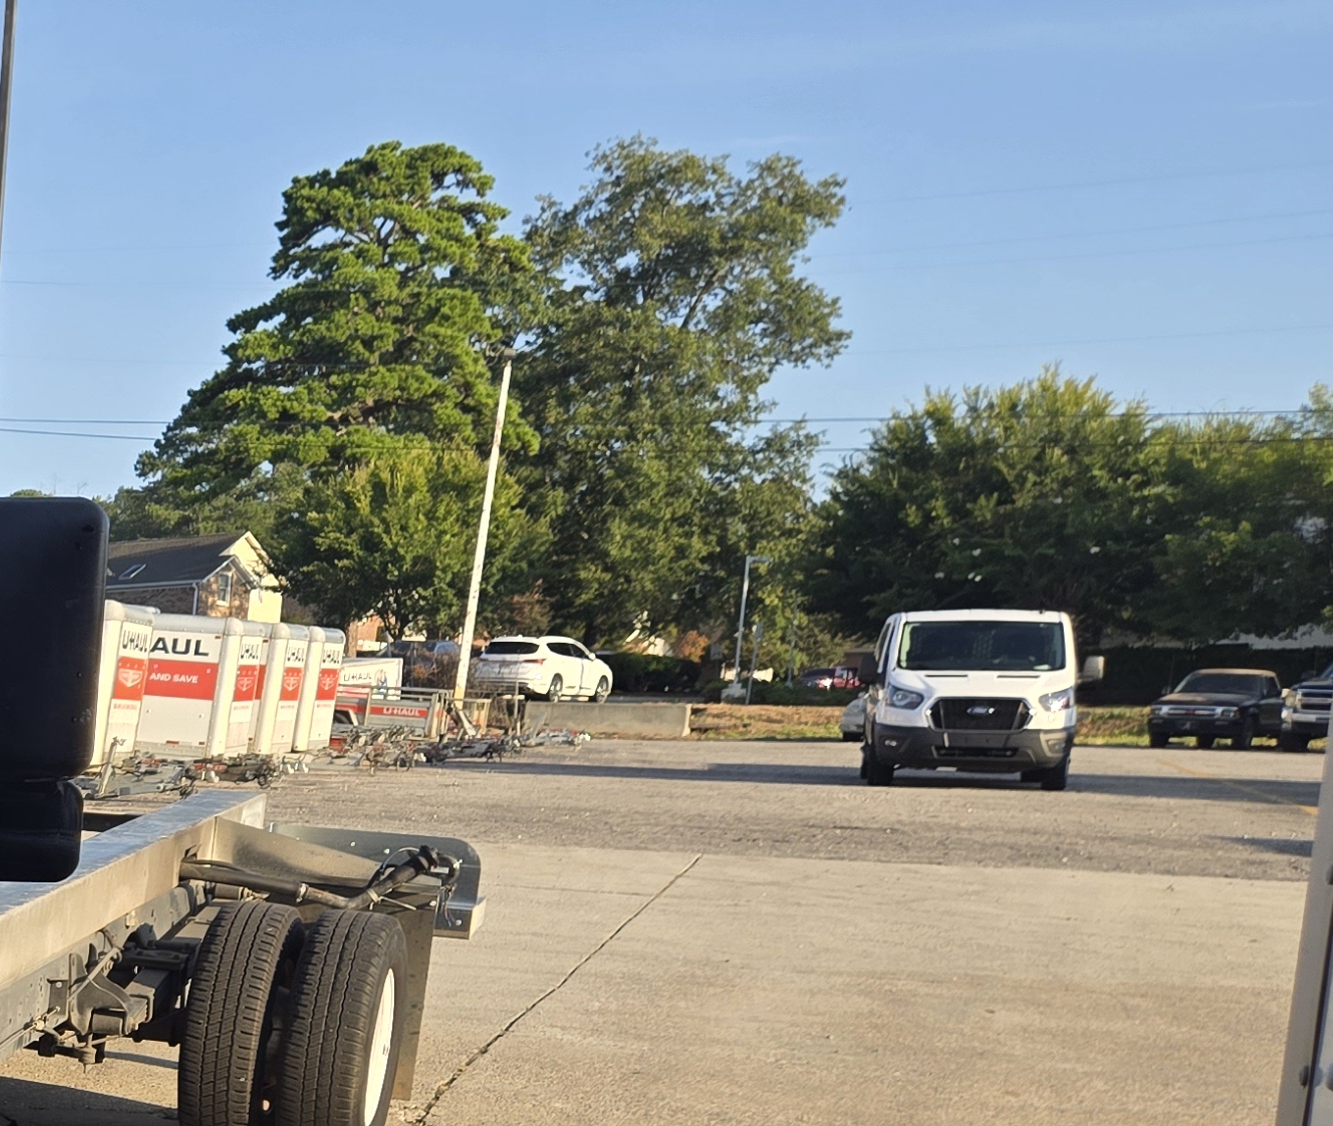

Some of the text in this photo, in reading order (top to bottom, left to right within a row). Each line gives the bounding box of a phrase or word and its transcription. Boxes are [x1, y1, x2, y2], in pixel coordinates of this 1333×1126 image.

[149, 636, 210, 657] AUL
[149, 672, 199, 684] AND SAVE
[383, 706, 421, 717] U-HAUL
